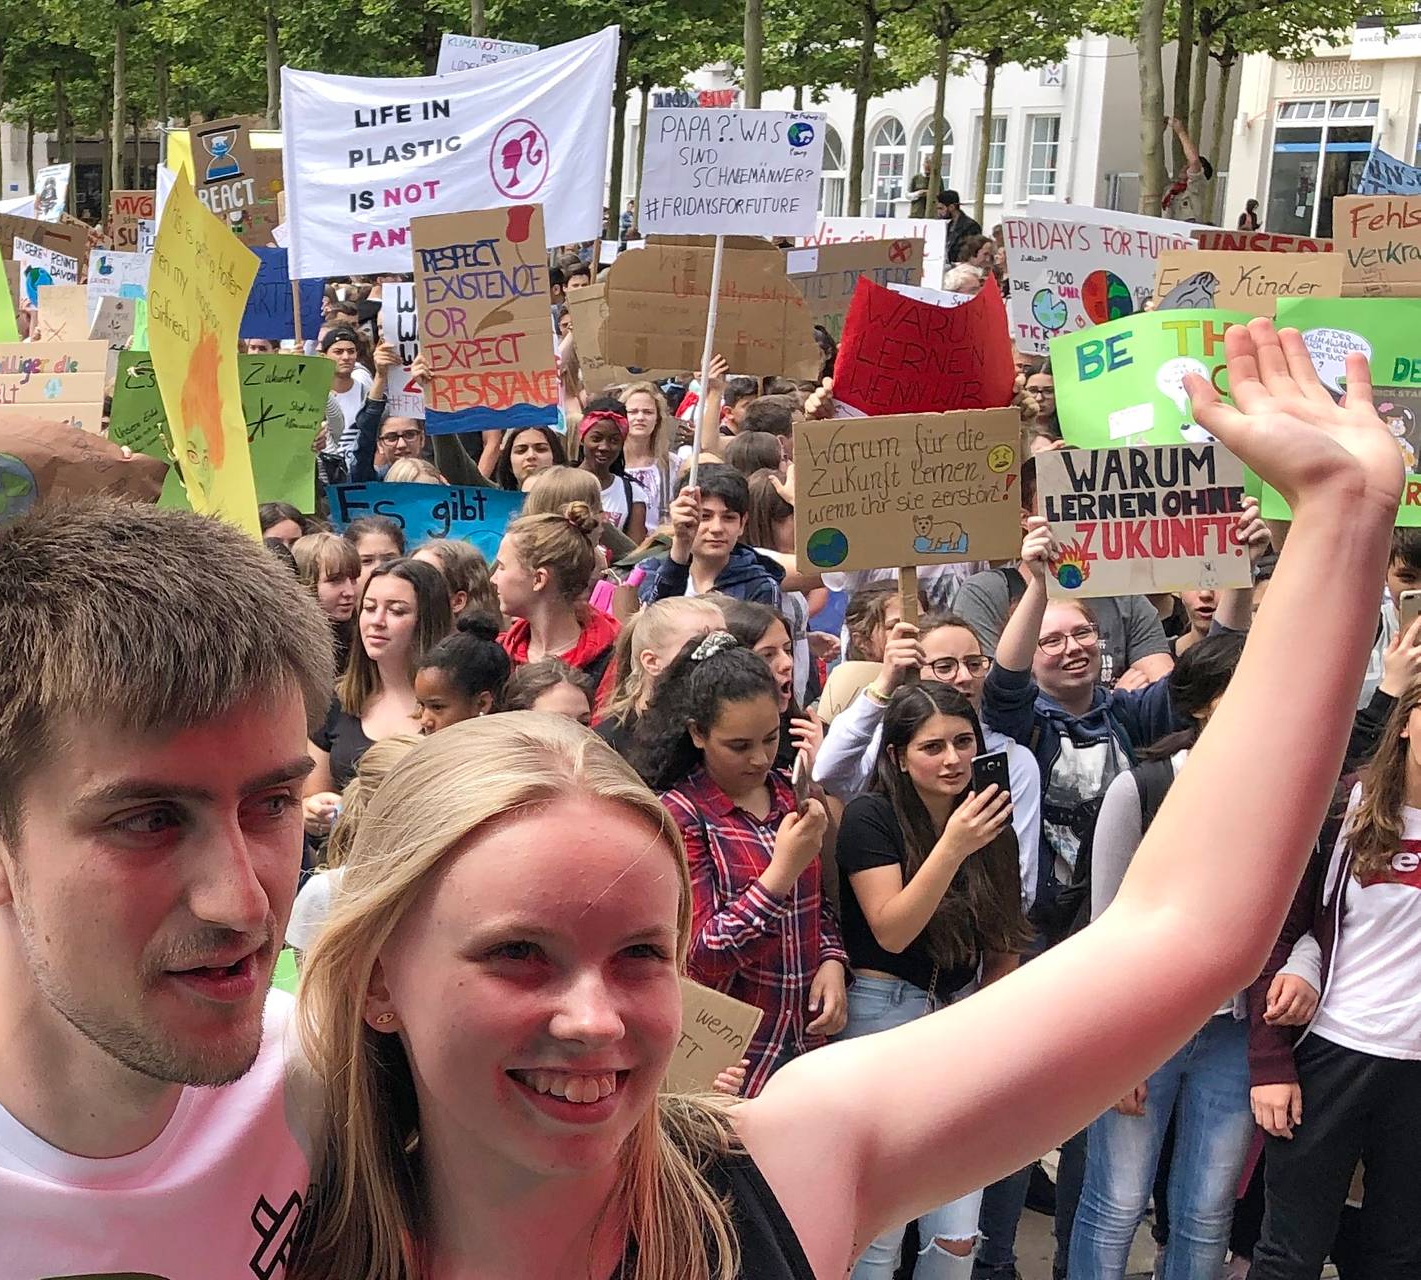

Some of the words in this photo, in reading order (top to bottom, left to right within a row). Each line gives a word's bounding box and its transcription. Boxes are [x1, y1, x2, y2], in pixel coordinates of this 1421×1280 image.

[1285, 61, 1361, 78] STADTWERKE
[354, 104, 412, 128] LIFE
[422, 99, 450, 120] IN
[740, 118, 782, 144] WAS
[348, 135, 462, 168] PLASTIC
[679, 146, 718, 166] SIND
[115, 196, 153, 217] MVG
[198, 178, 255, 214] REACT
[350, 190, 375, 213] IS
[383, 180, 441, 208] NOT
[645, 196, 801, 221] #FRIDAYSFORFUTURE
[1004, 220, 1092, 252] FRIDAYS
[1099, 226, 1132, 256] FOR
[416, 238, 501, 274] RESPECT
[422, 263, 547, 305] EXISTENCE
[1013, 279, 1031, 292] DIE
[1230, 264, 1322, 298] Kinder
[424, 306, 470, 340] OR
[53, 353, 79, 374] die
[423, 332, 527, 373] EXPECT
[855, 331, 985, 375] LERNEN
[1075, 330, 1134, 382] BE
[430, 369, 560, 411] RESISTANCE
[803, 424, 900, 467] Warum
[914, 421, 949, 470] für
[956, 419, 989, 452] die
[1060, 445, 1217, 493] WARUM
[427, 488, 488, 539] gibt
[807, 502, 858, 526] wenn
[861, 493, 893, 516] ihr
[895, 495, 925, 512] sie
[1044, 491, 1157, 523] LERNEN
[1161, 486, 1246, 518] OHNE
[694, 1008, 744, 1051] wenn
